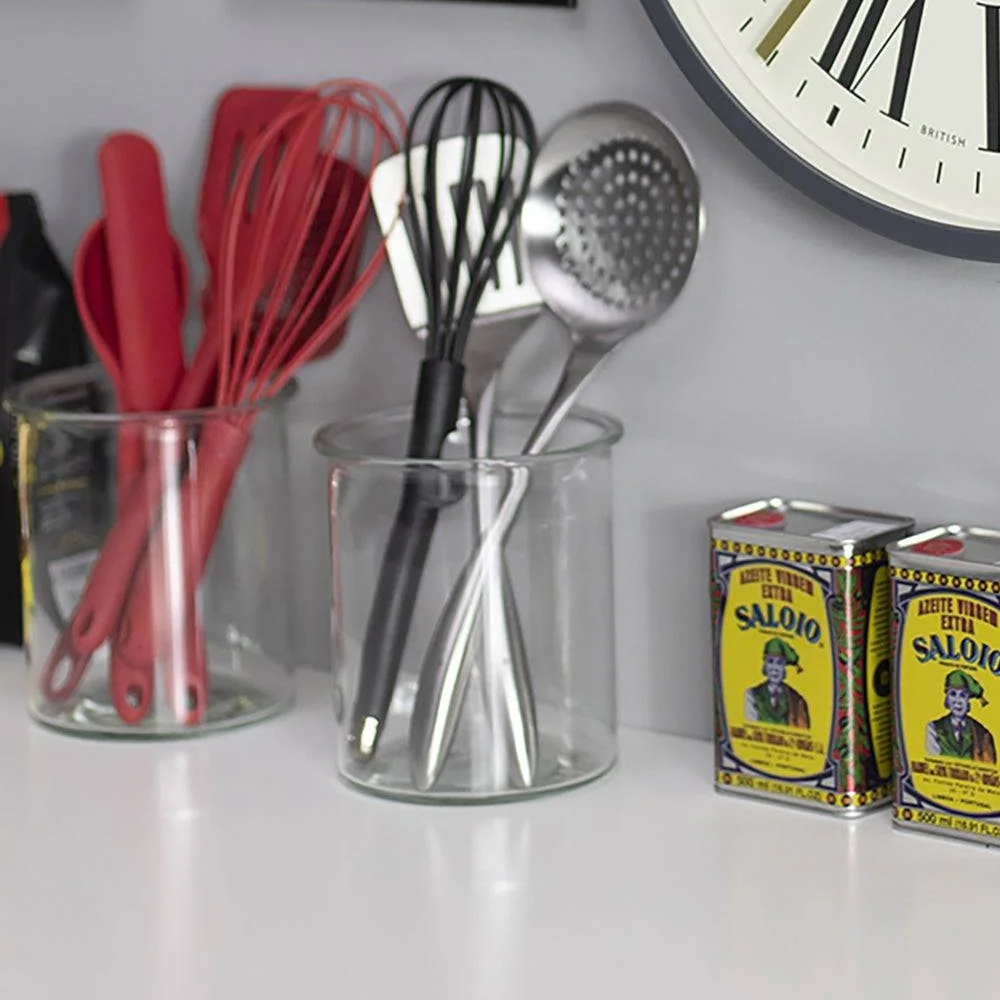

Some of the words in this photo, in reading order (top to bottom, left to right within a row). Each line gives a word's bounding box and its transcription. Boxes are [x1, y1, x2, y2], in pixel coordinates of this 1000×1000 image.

[919, 123, 968, 148] BRITISH
[734, 602, 821, 644] SALOIO
[940, 614, 976, 636] EXTRA
[918, 808, 937, 822] 500
